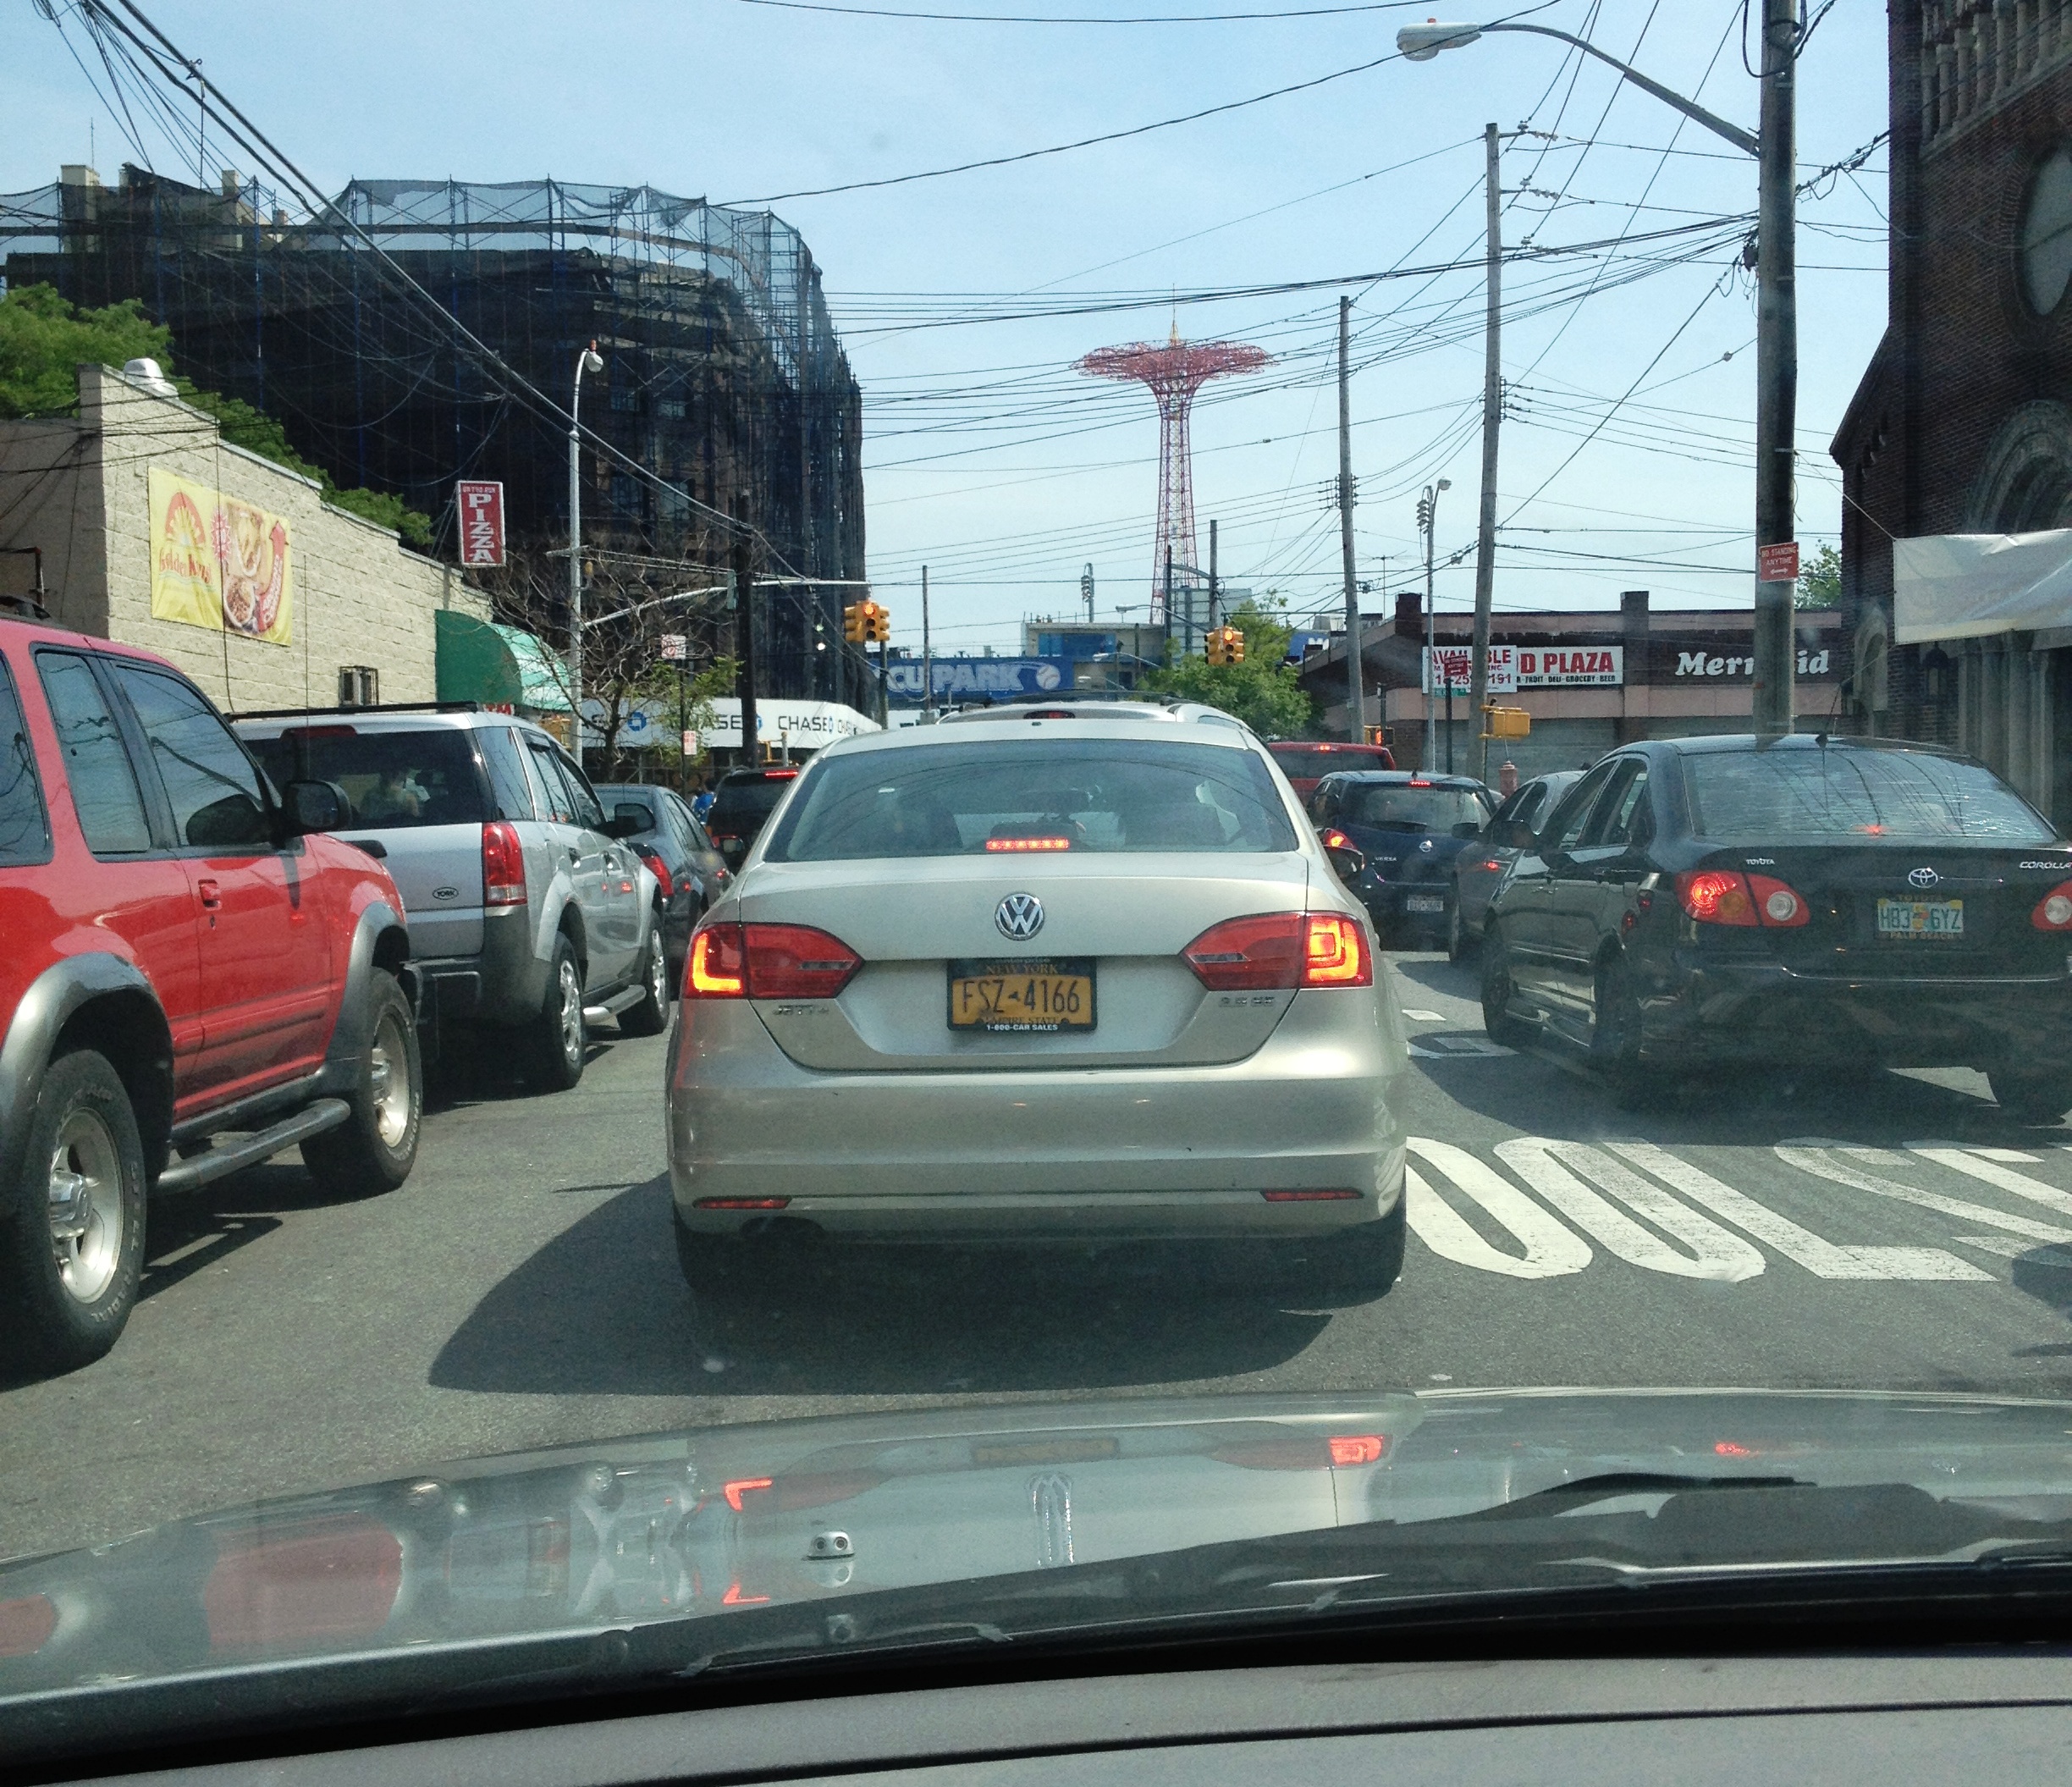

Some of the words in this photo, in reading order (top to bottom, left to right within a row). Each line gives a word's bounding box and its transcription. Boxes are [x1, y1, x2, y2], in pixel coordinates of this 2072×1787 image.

[468, 493, 495, 563] PIZZA
[1543, 652, 1615, 673] PLAZA
[1675, 649, 1830, 676] Merid
[932, 664, 1024, 692] PARK
[778, 715, 828, 732] CHASE
[986, 965, 1017, 974] NEW
[1022, 964, 1059, 974] YORK
